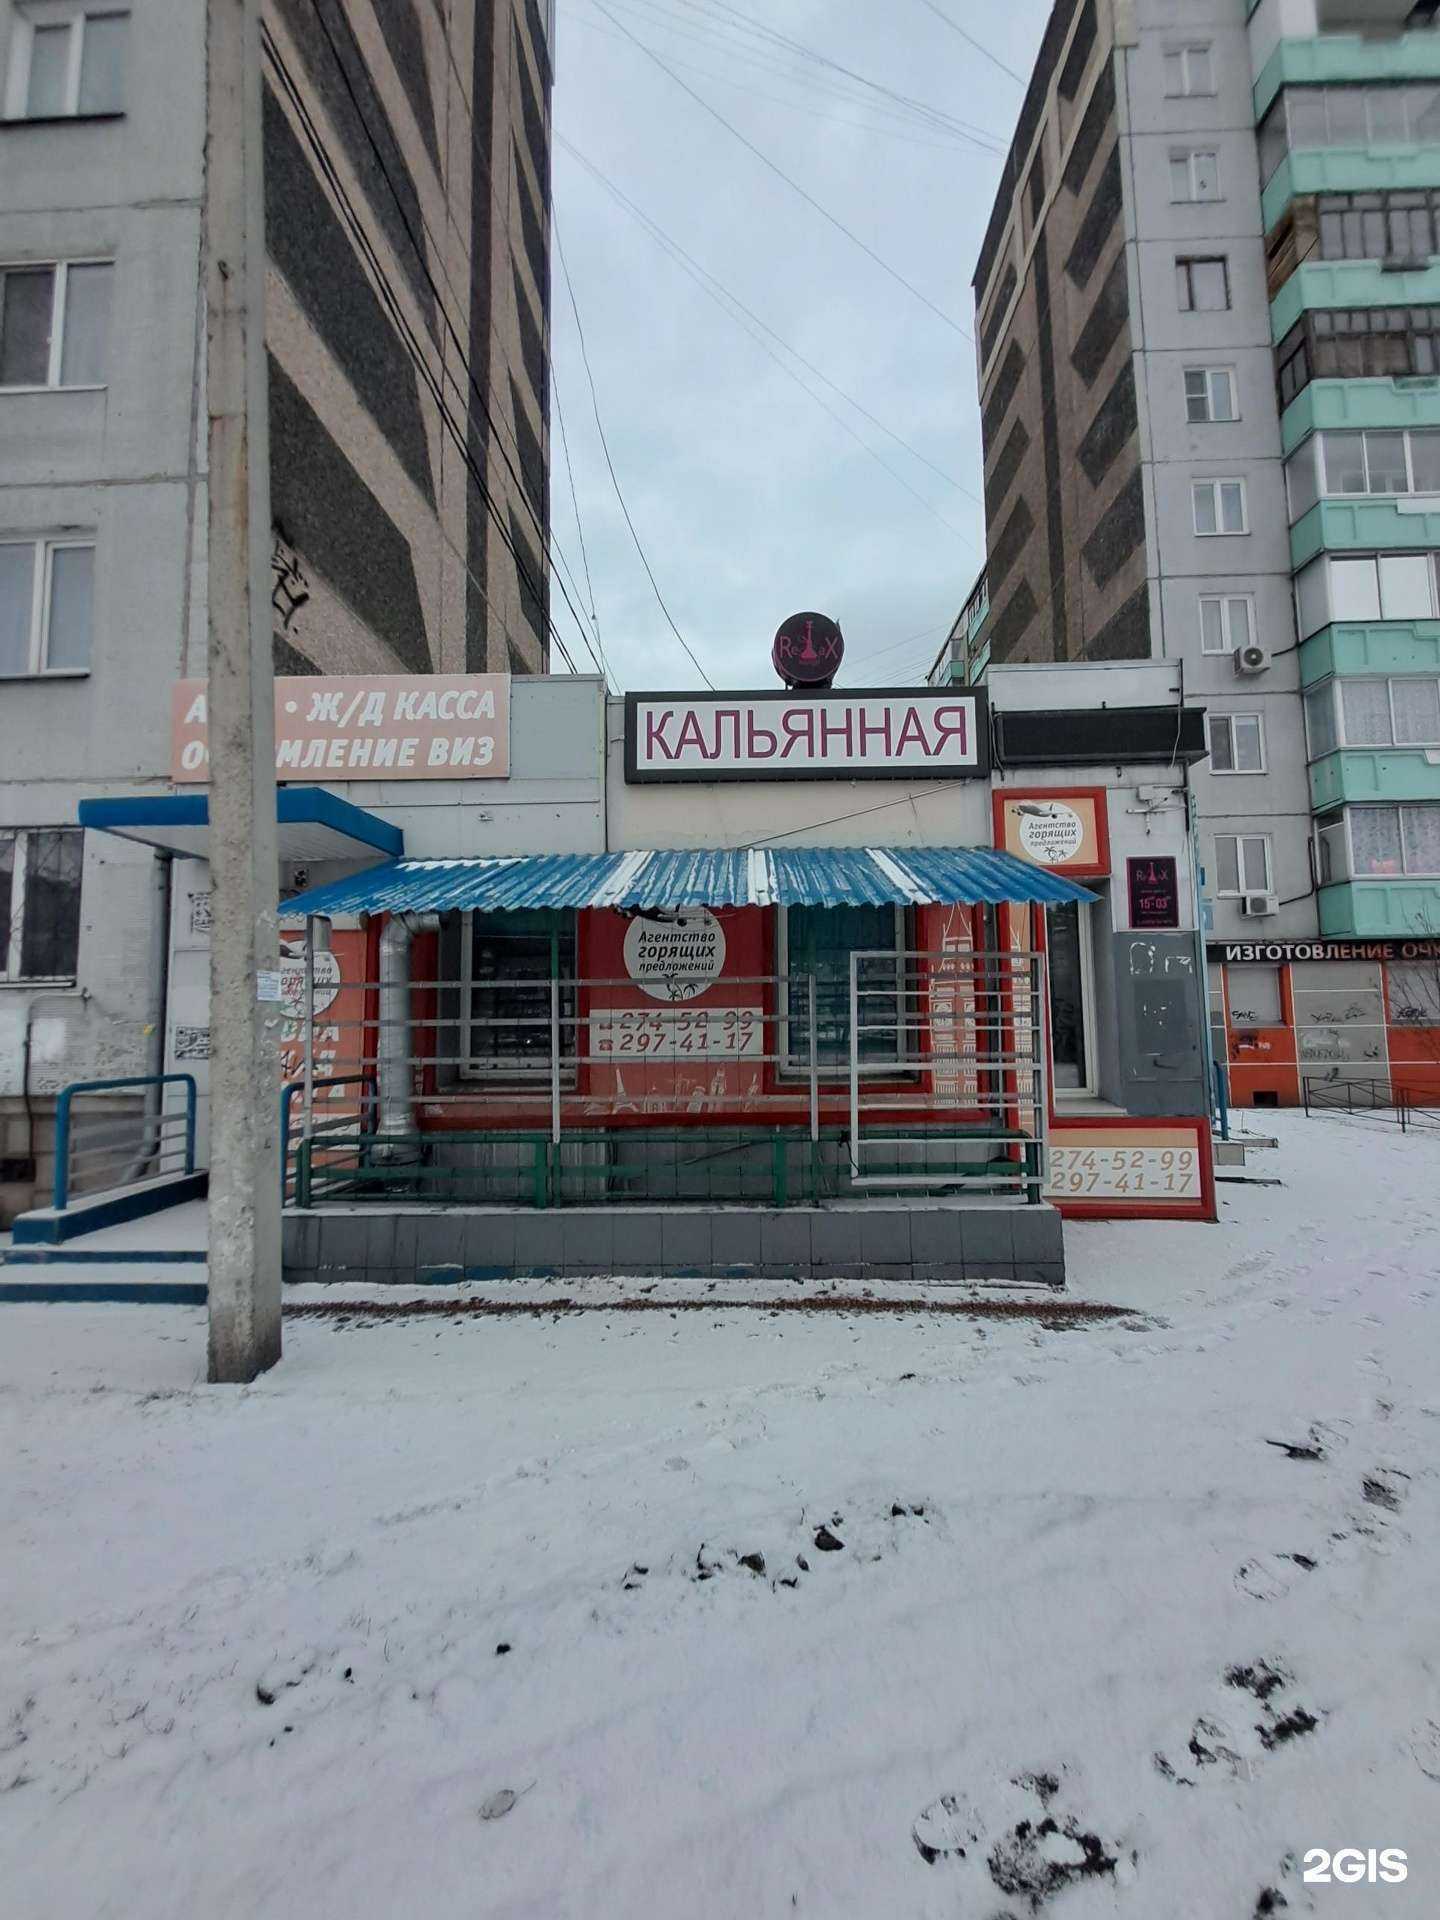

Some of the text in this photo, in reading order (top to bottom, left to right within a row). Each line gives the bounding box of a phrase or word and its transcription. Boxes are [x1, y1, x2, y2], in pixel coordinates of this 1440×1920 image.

[306, 689, 496, 728] Ж/Д КАССА
[645, 706, 968, 760] КАЛЬЯННАЯ
[182, 736, 495, 770] ОМЛЕНИЕ ВИЗ
[1028, 821, 1077, 830] Агентство
[1028, 829, 1077, 839] горящих
[638, 931, 716, 943] Агентство
[638, 943, 716, 960] горящих
[1226, 943, 1393, 961] ИЗГОТОВЛЕНИЕ
[638, 960, 715, 973] предложений
[619, 1033, 754, 1052] 297-41-17
[1051, 1150, 1193, 1171] 274-52-99
[1051, 1172, 1193, 1193] 297-41-17
